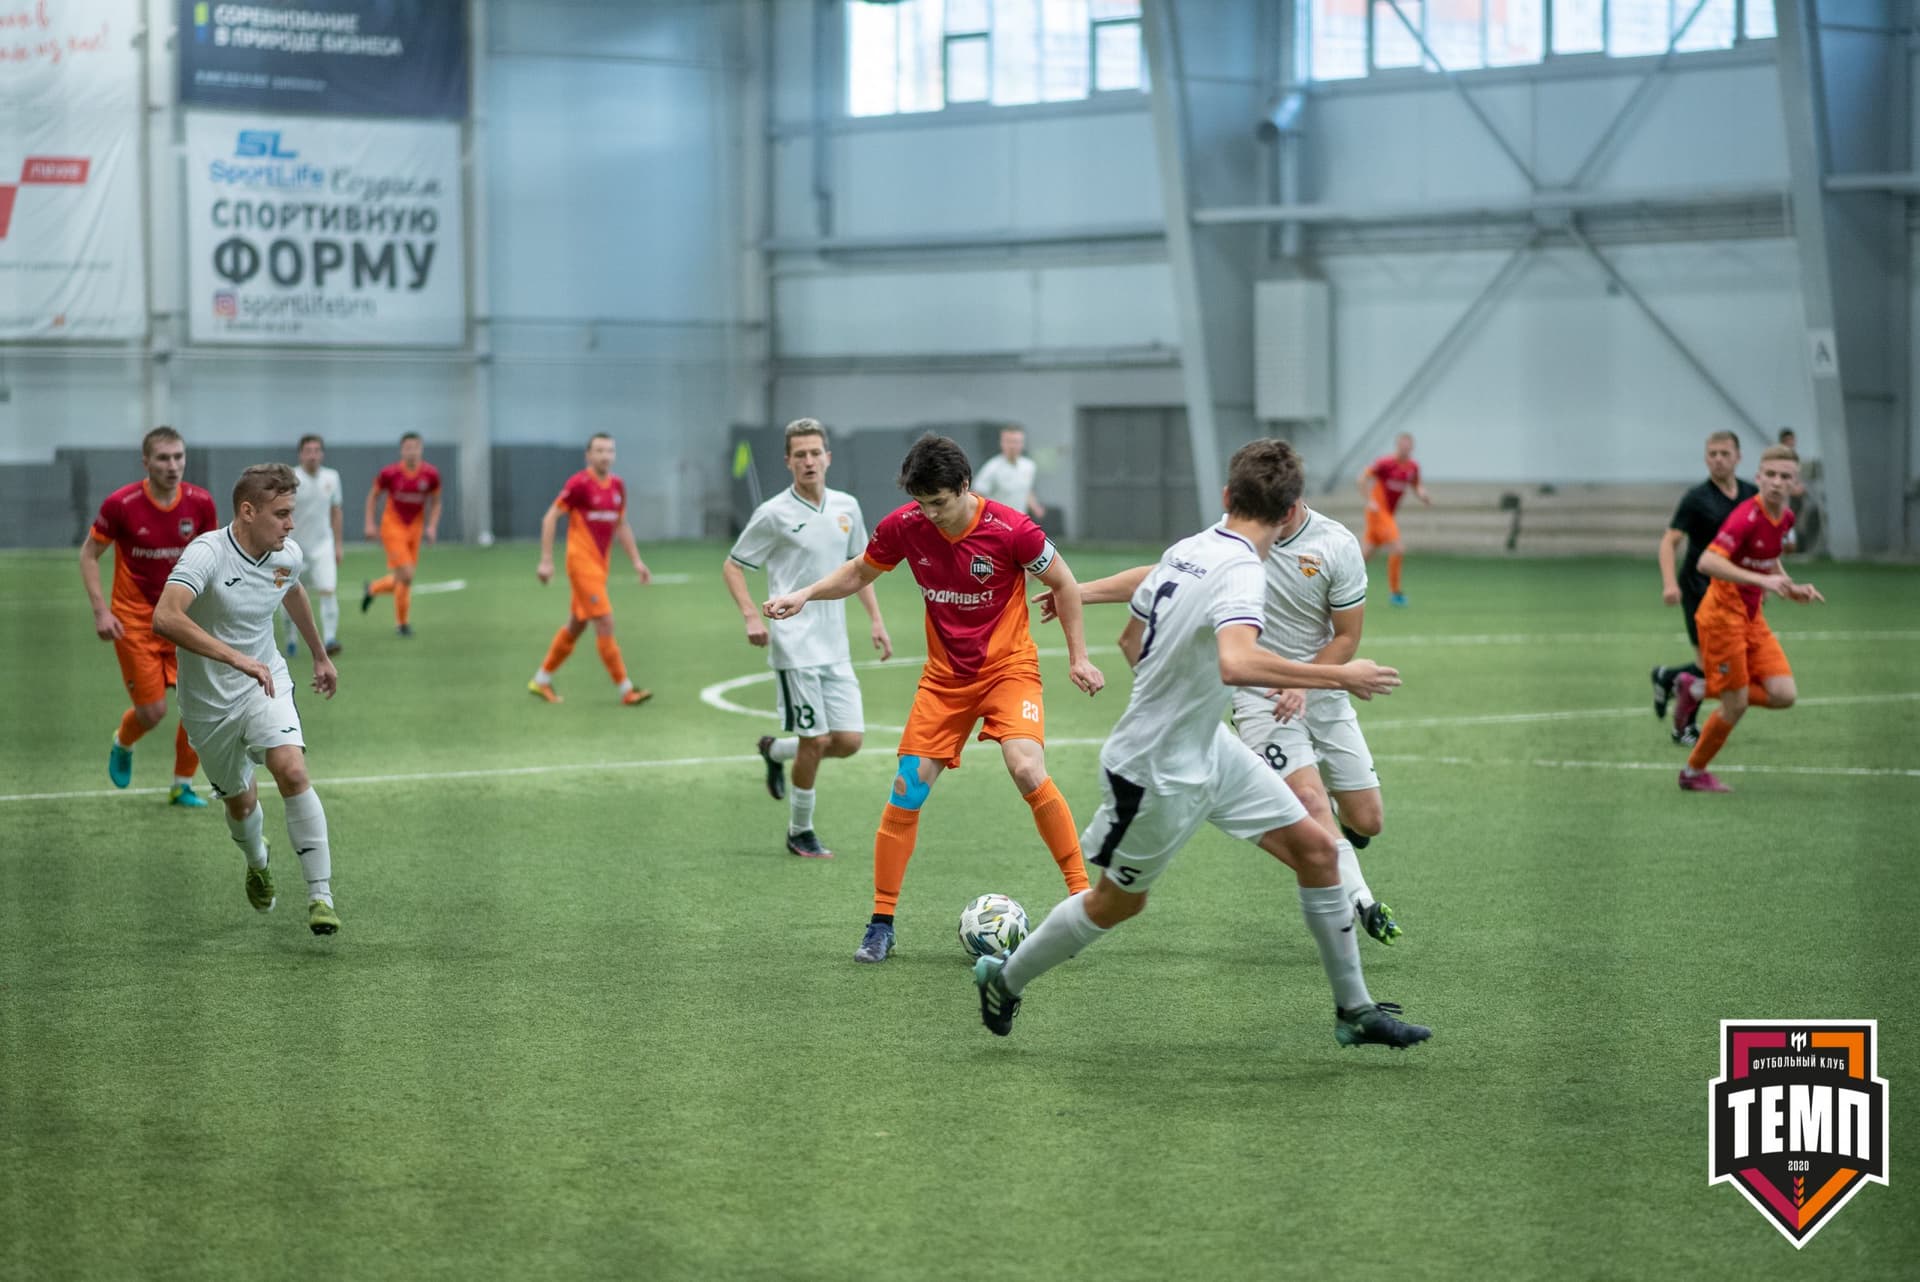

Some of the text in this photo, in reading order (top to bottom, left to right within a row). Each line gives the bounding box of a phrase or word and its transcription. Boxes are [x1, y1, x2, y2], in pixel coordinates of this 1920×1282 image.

[211, 198, 439, 234] СПОРТИВНУЮ
[212, 236, 437, 291] ФОРМУ
[1022, 700, 1039, 722] 23
[1117, 865, 1142, 886] 5
